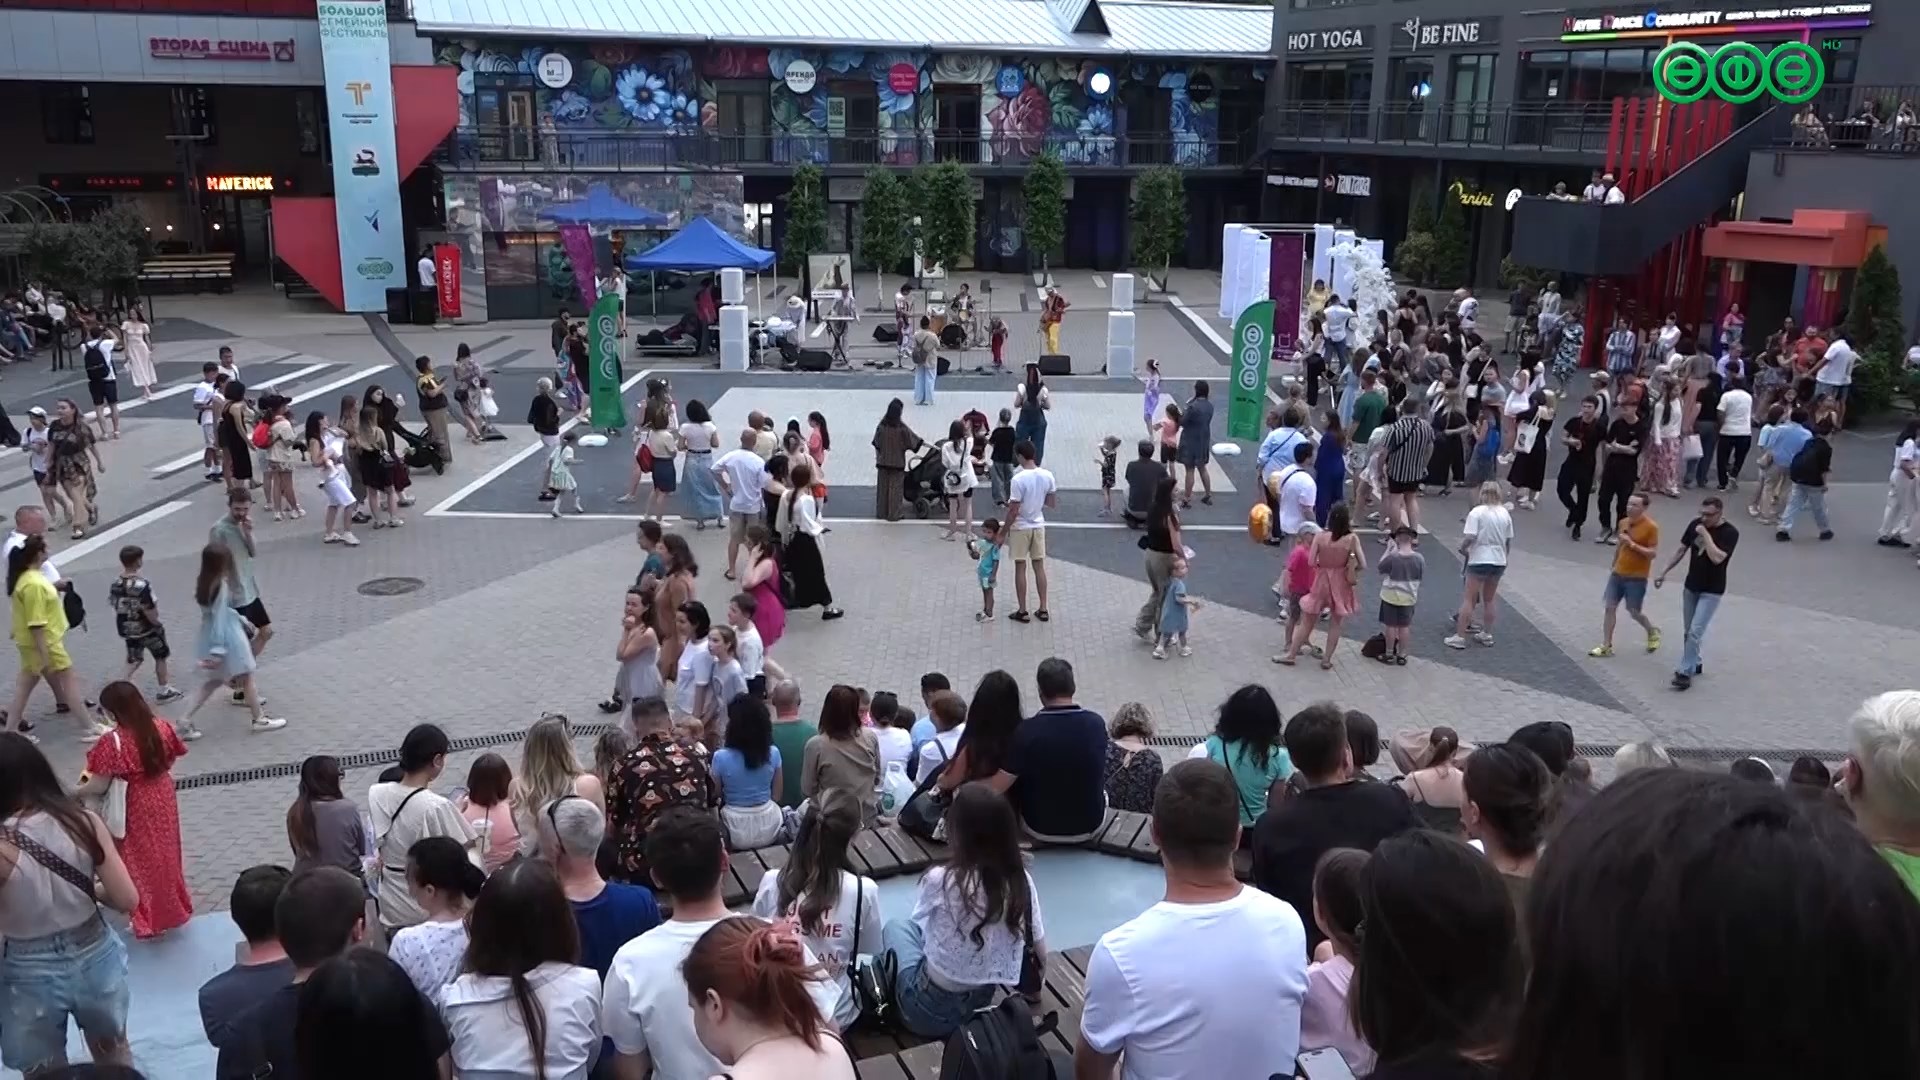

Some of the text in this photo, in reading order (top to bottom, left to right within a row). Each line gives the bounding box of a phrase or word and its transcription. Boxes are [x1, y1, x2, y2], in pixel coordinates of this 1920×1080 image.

[319, 5, 385, 16] БОЛЬШОЙ
[320, 17, 386, 27] СЕМЕЙНЫЙ
[320, 28, 388, 38] ФЕСТИВАЛЬ
[1288, 29, 1363, 50] HOT YOGA
[1420, 22, 1480, 44] BE FINE
[150, 38, 271, 53] ВТОРАЯ СЦЕНА
[206, 176, 274, 190] MAVERICK
